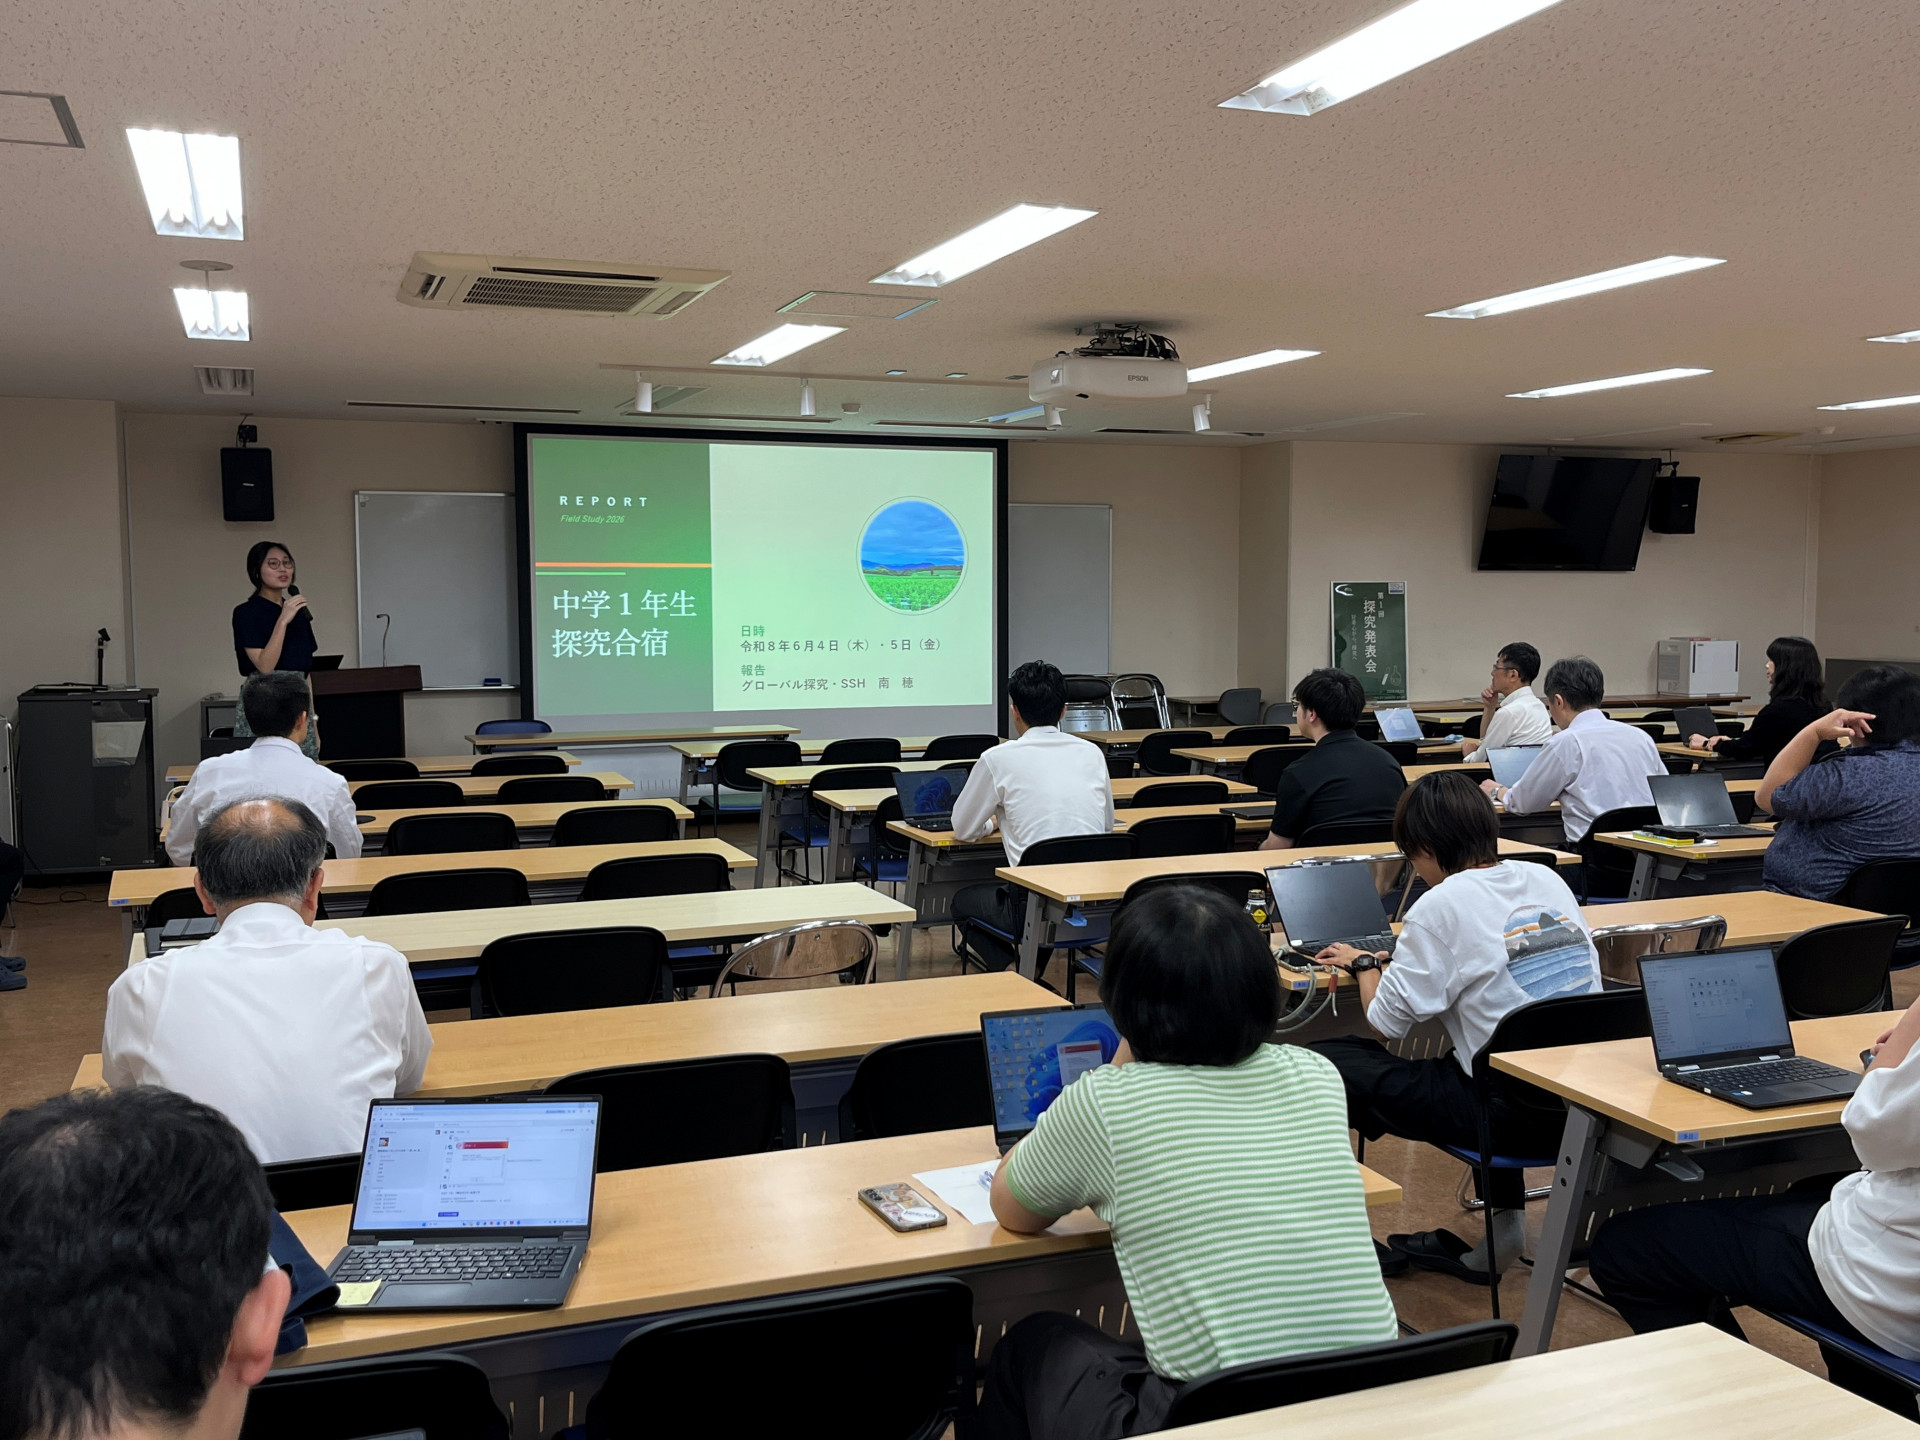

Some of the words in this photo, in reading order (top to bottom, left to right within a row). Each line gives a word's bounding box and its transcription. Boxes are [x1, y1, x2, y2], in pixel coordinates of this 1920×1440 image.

[1127, 374, 1149, 382] EPSON
[559, 495, 648, 507] REPORT
[560, 514, 580, 523] Field
[582, 514, 604, 524] Study
[605, 515, 625, 523] 2026
[553, 589, 697, 619] 中学1年生
[741, 625, 765, 637] 日時
[1363, 600, 1377, 673] 探究発表会
[552, 627, 669, 658] 探究合宿
[741, 664, 766, 677] 報告
[741, 678, 866, 692] グローバル探究・SSH
[878, 677, 890, 689] 南
[902, 677, 914, 689] 穂
